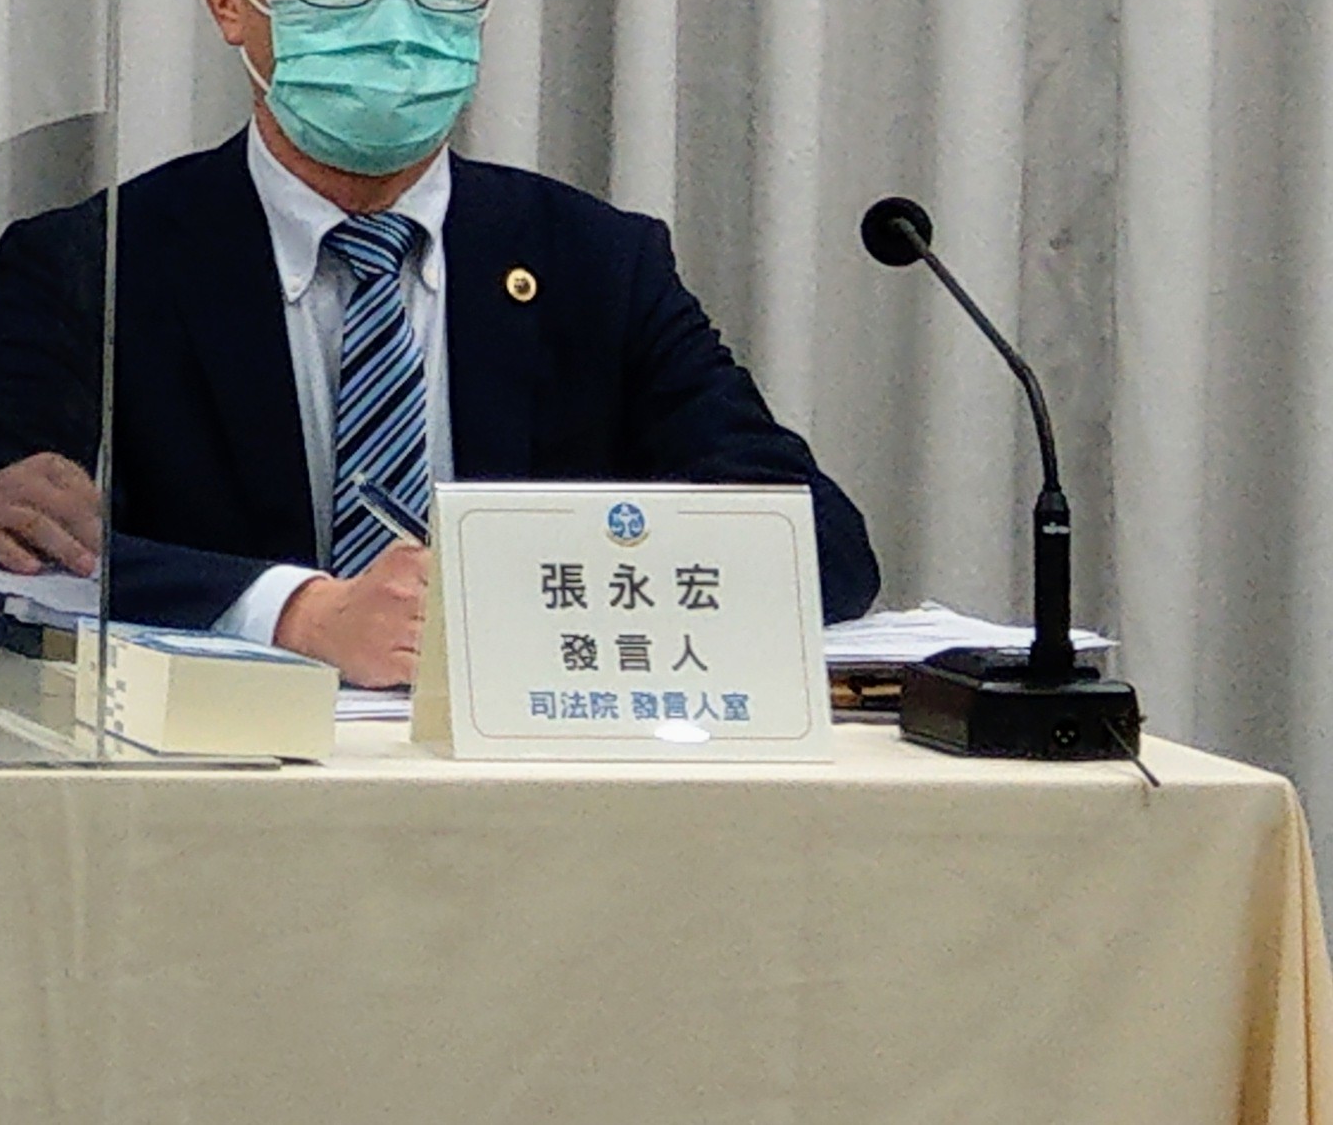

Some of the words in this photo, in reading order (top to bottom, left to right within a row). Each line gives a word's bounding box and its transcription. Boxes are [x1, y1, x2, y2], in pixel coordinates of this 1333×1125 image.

[540, 563, 721, 611] 張永宏
[560, 634, 709, 673] 發言人
[529, 691, 621, 721] 司法院
[631, 691, 752, 723] 發言人室
